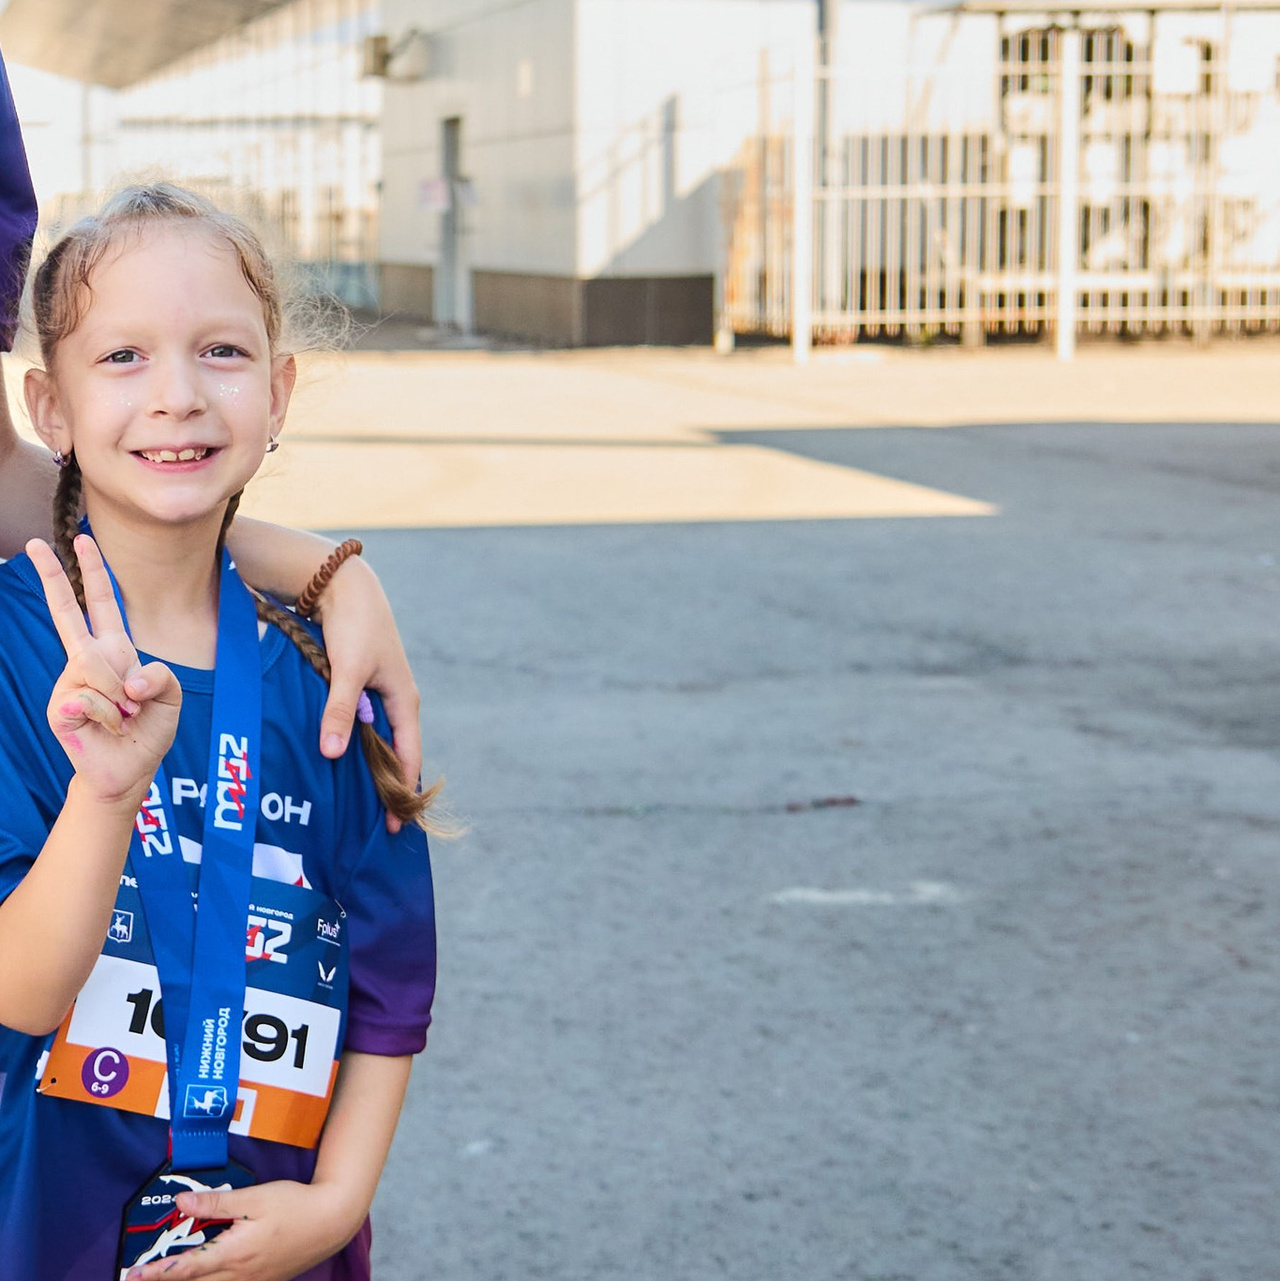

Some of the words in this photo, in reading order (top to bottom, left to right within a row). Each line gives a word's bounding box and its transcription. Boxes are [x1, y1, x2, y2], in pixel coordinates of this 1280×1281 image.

[125, 987, 310, 1070] 191
[198, 1018, 216, 1079] НИЖНИЙ
[212, 1006, 231, 1080] НОВГОРОД
[91, 1080, 109, 1095] 6-9
[141, 1194, 177, 1205] 202
